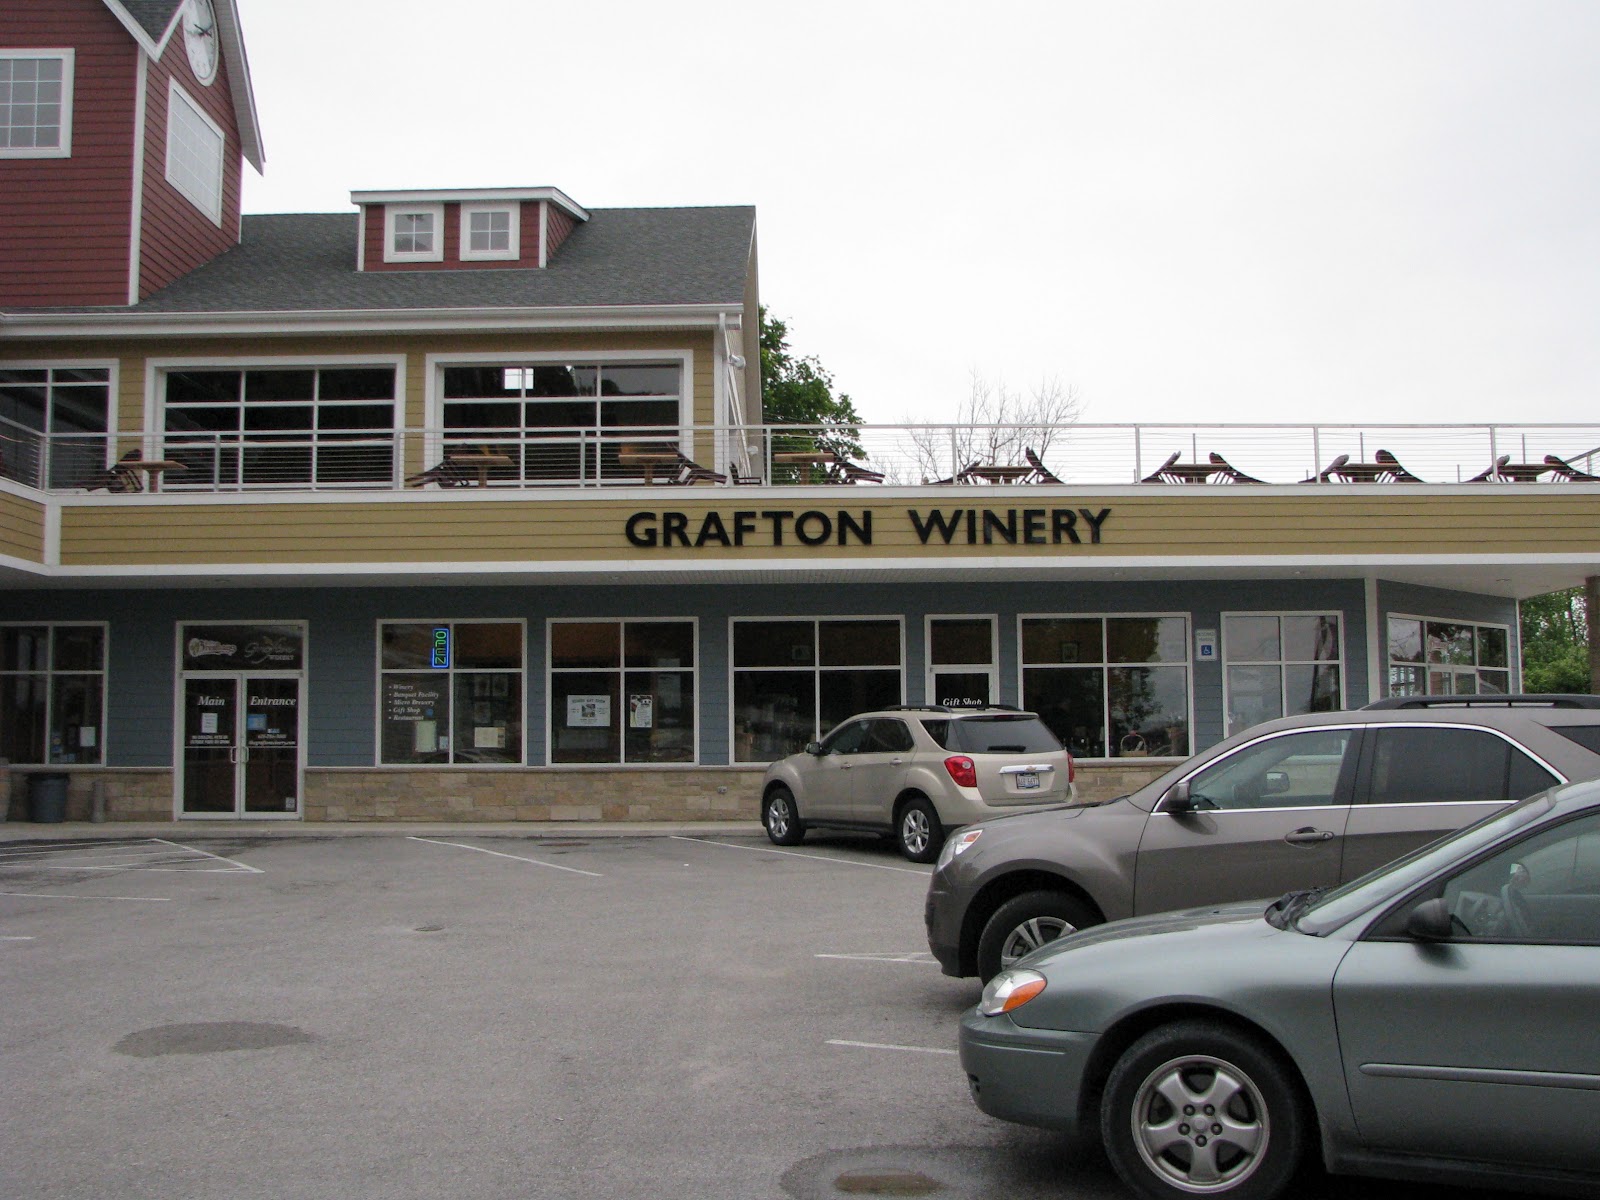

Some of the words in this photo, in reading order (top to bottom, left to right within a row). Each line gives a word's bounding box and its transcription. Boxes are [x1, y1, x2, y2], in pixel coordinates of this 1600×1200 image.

[625, 509, 872, 547] GRAFTON
[907, 508, 1112, 545] WINERY
[434, 630, 447, 665] OPEN
[418, 691, 439, 699] Facility
[197, 695, 225, 706] Main
[250, 695, 296, 706] Entrance
[942, 697, 960, 707] Gift
[406, 706, 421, 714] Shop
